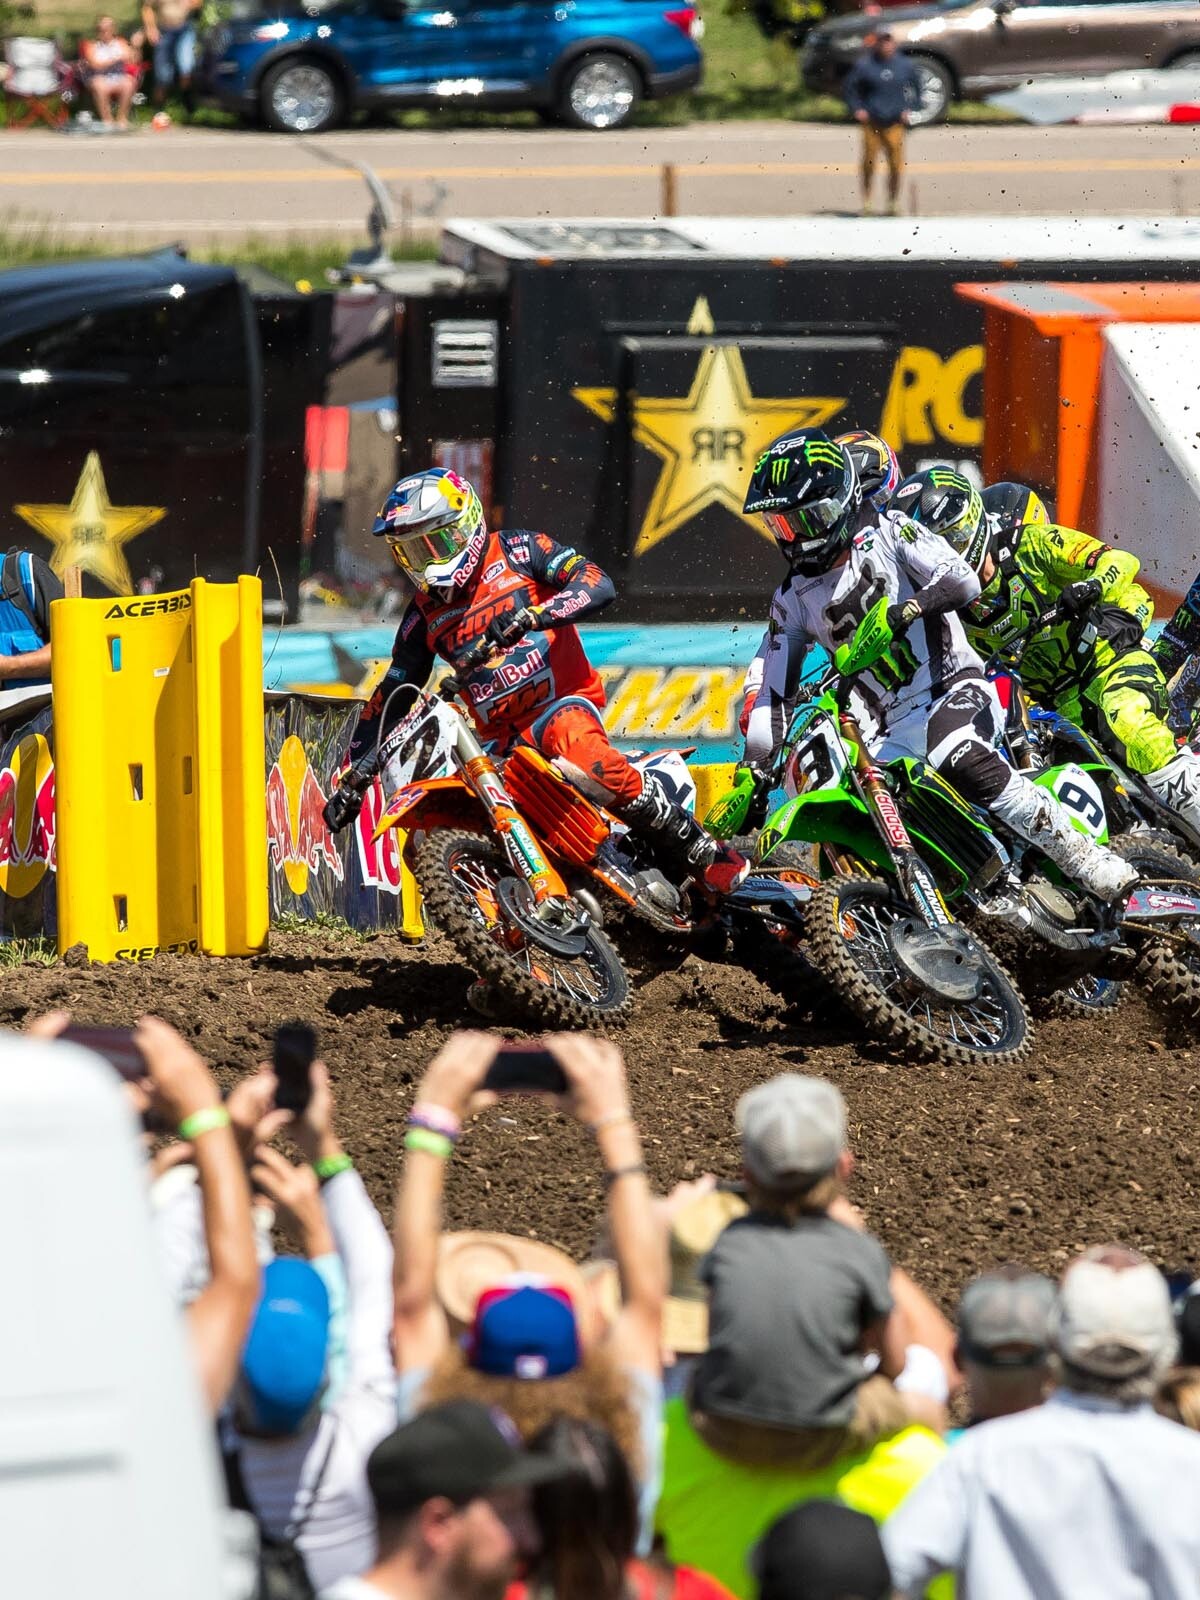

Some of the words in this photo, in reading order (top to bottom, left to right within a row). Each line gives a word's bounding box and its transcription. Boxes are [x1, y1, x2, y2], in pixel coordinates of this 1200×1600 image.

[745, 497, 788, 510] MONSTER
[470, 668, 508, 704] Red
[503, 648, 547, 690] Bull
[951, 740, 972, 768] pod
[874, 793, 911, 845] SHOWA
[1057, 781, 1105, 830] 9
[913, 869, 949, 925] DUNLOP
